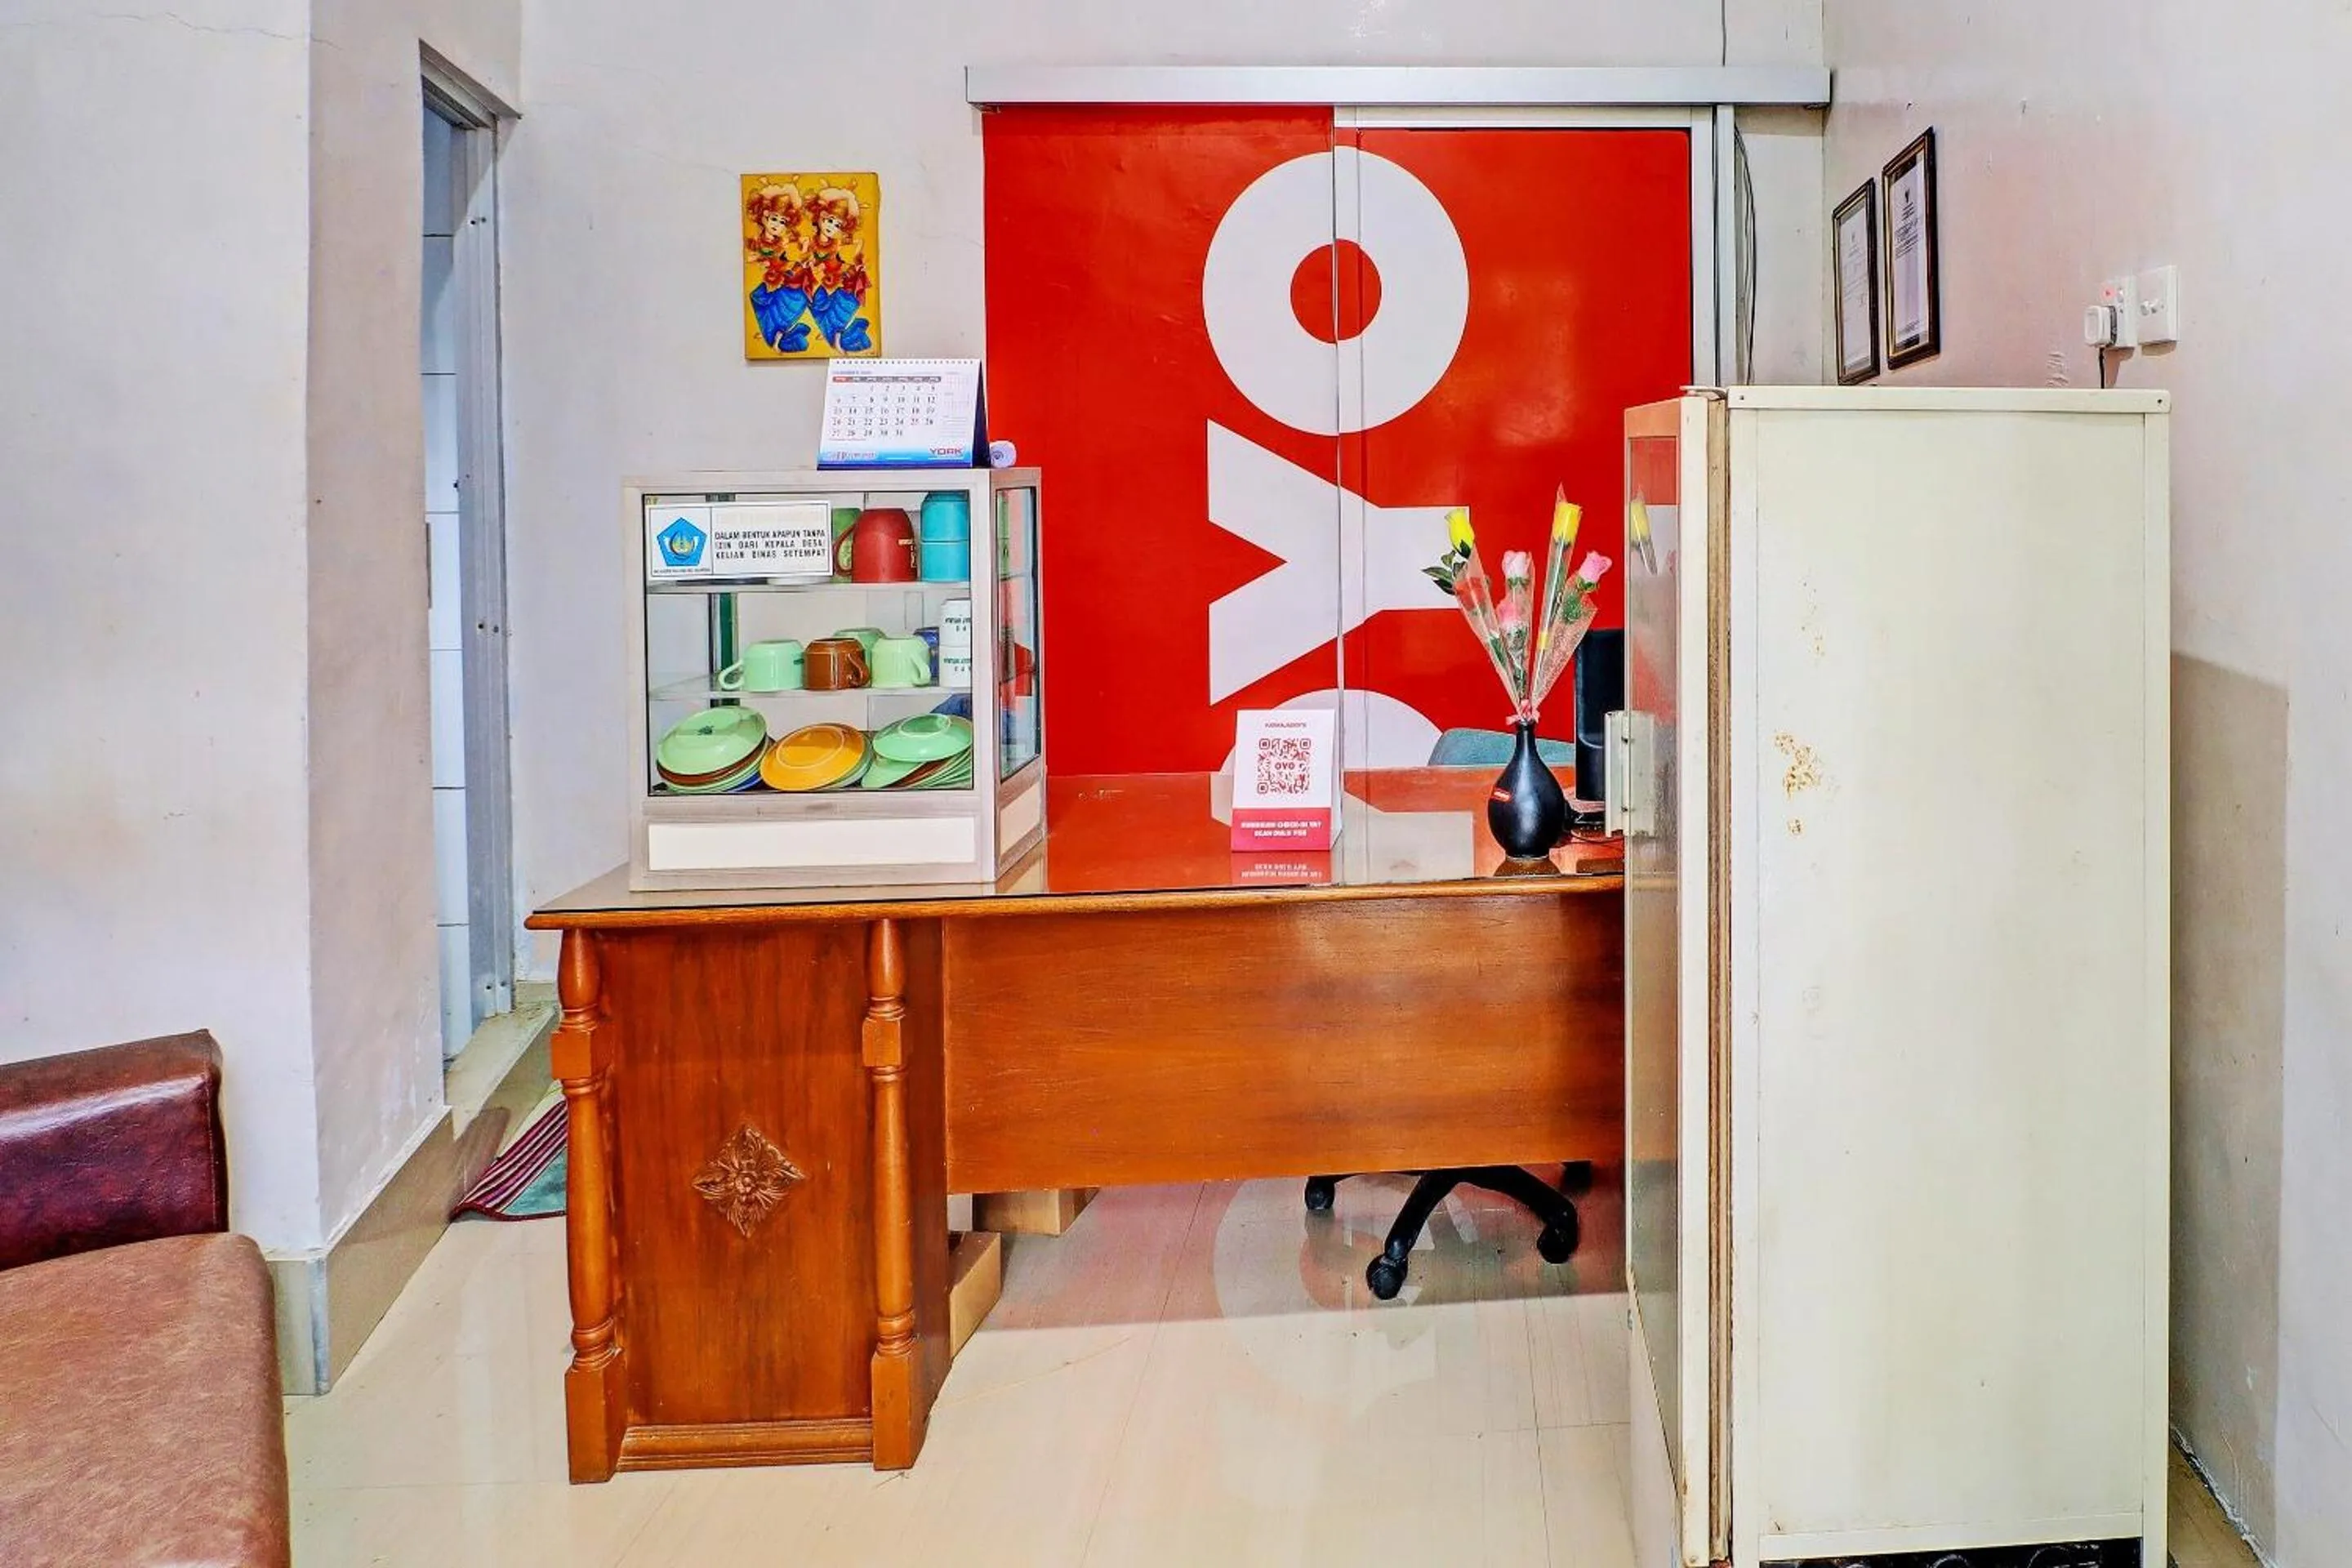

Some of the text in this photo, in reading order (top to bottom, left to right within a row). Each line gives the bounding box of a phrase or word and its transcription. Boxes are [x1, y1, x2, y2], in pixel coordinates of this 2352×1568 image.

[929, 448, 963, 456] YORK
[715, 529, 826, 540] DALAM BENTUK APAPUN TANPA
[738, 540, 758, 549] DARI
[765, 540, 795, 548] KEPALA
[715, 550, 744, 559] KELIAN
[783, 549, 826, 558] SETEMPAT
